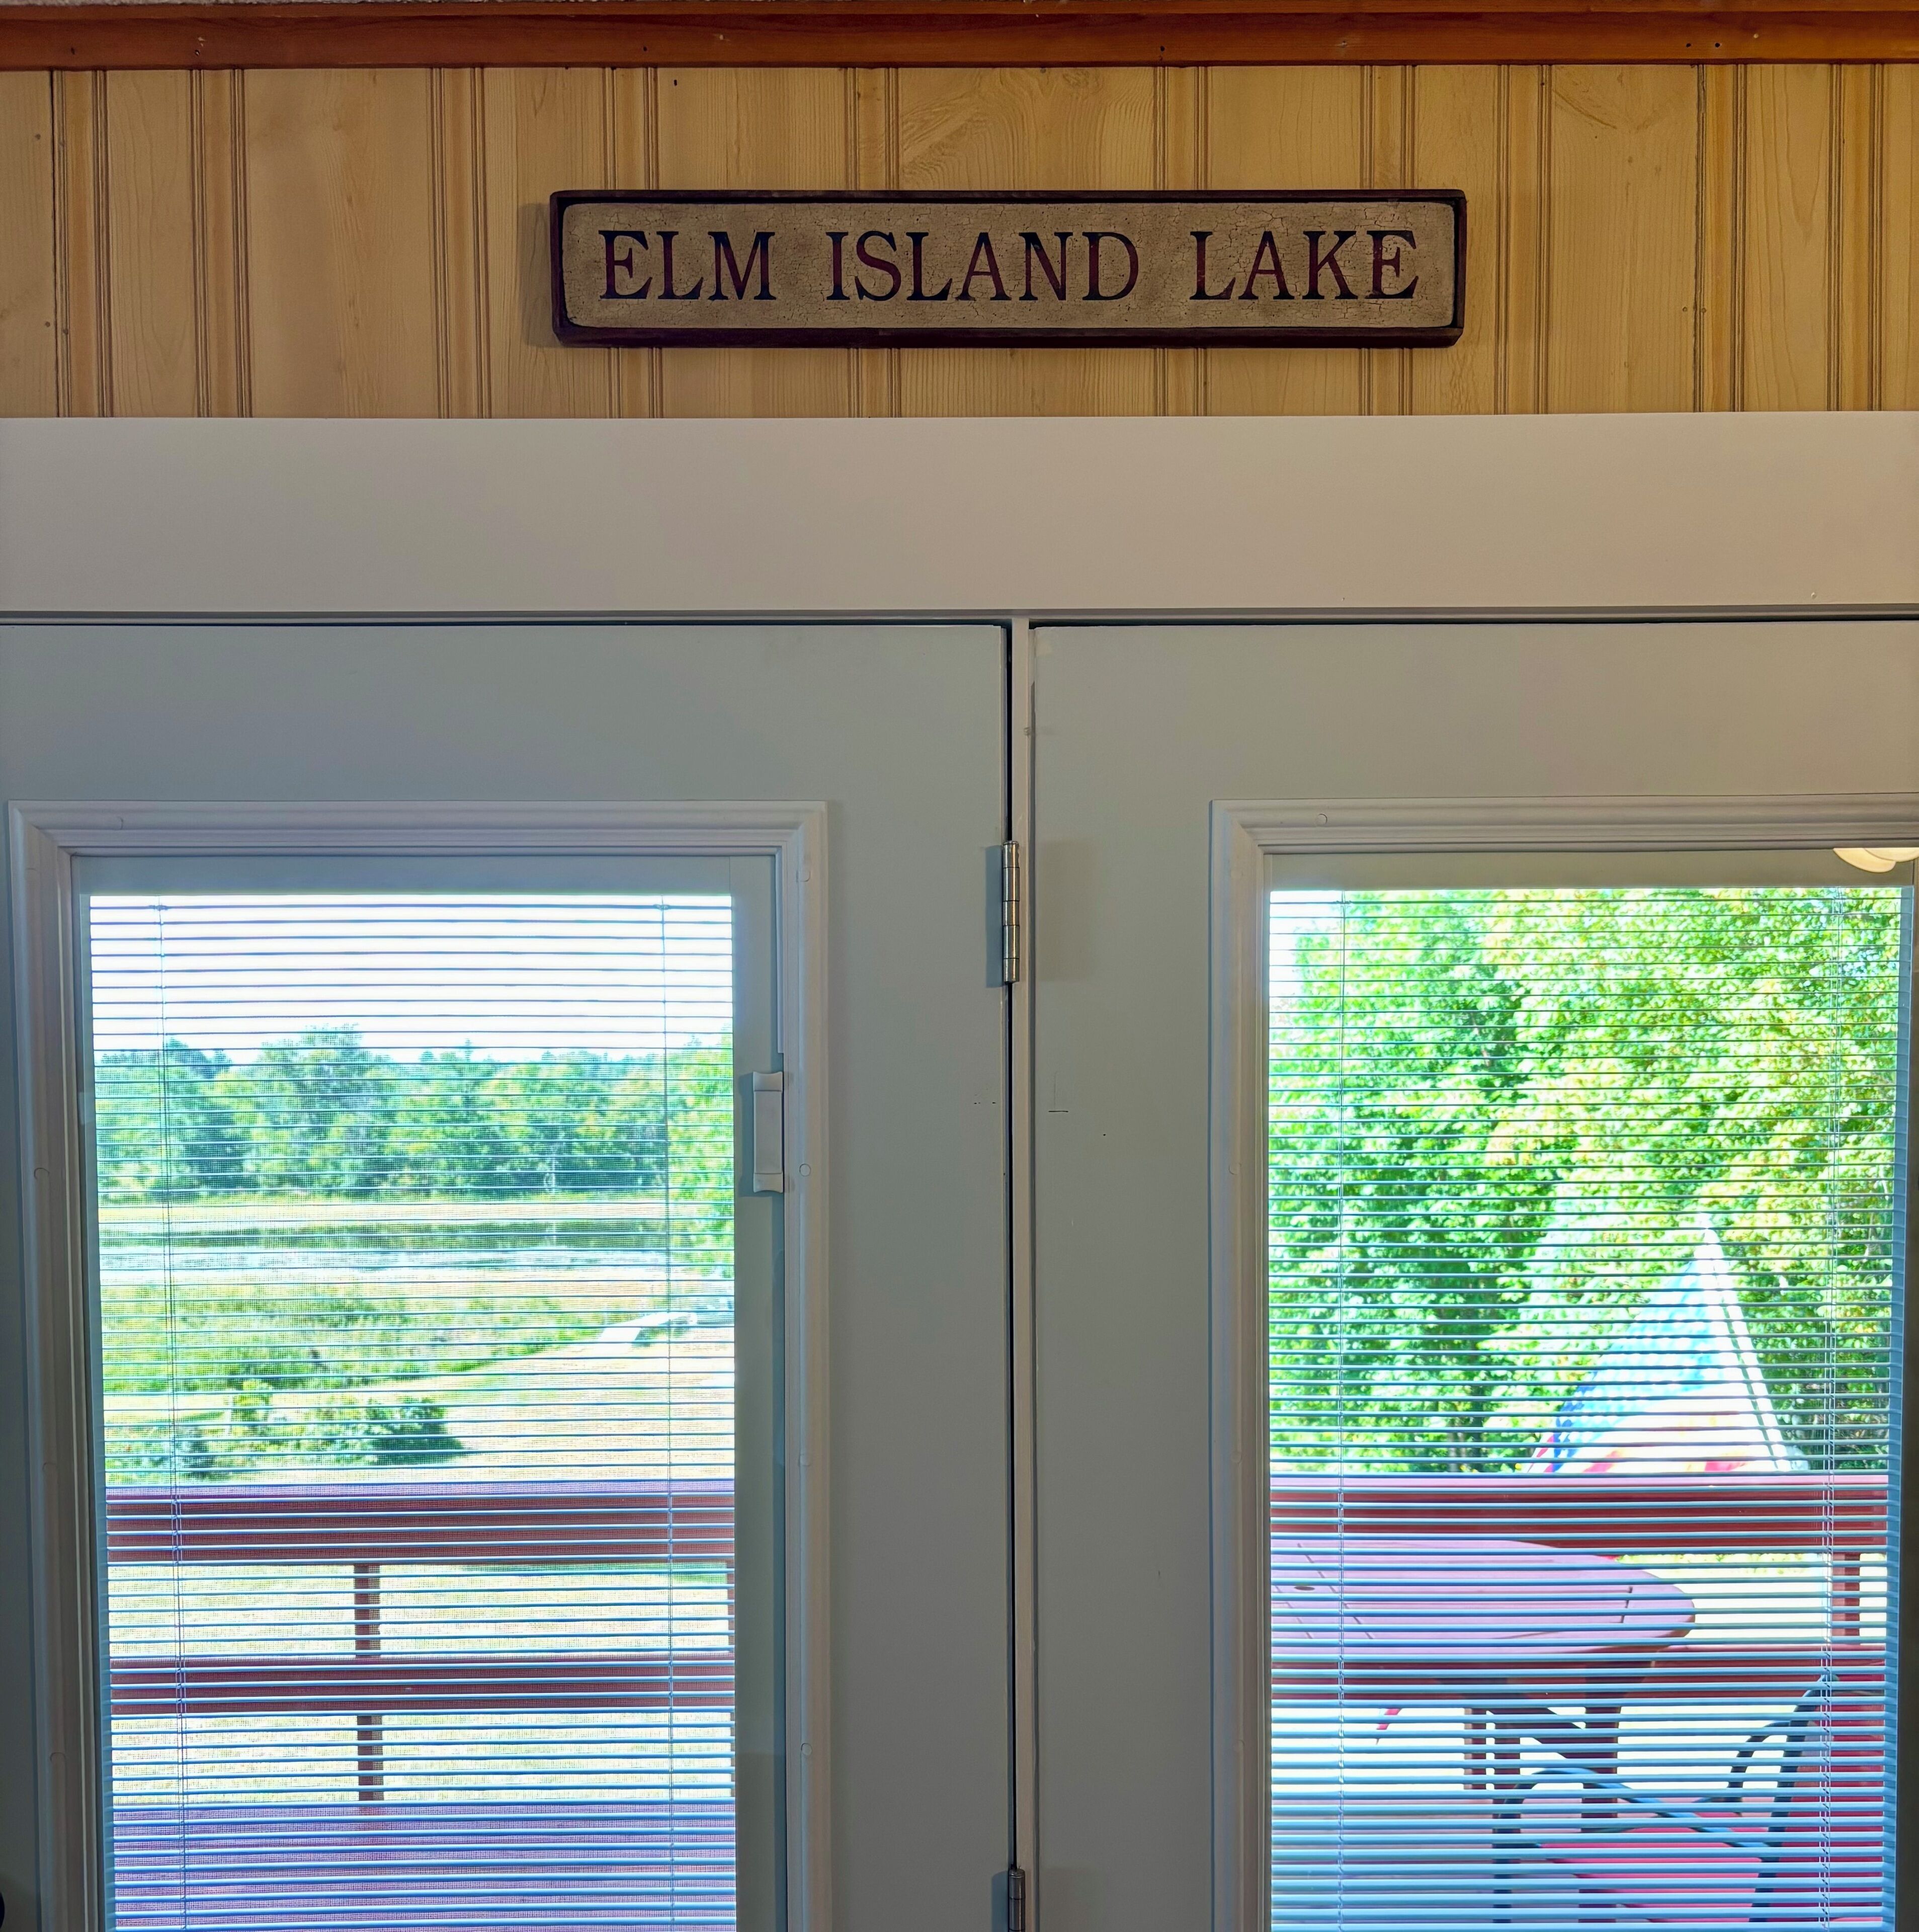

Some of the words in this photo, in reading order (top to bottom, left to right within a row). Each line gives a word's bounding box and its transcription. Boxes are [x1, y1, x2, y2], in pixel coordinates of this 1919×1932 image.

[600, 230, 777, 300] ELM
[825, 230, 1139, 301] ISLAND
[1189, 230, 1419, 300] LAKE
